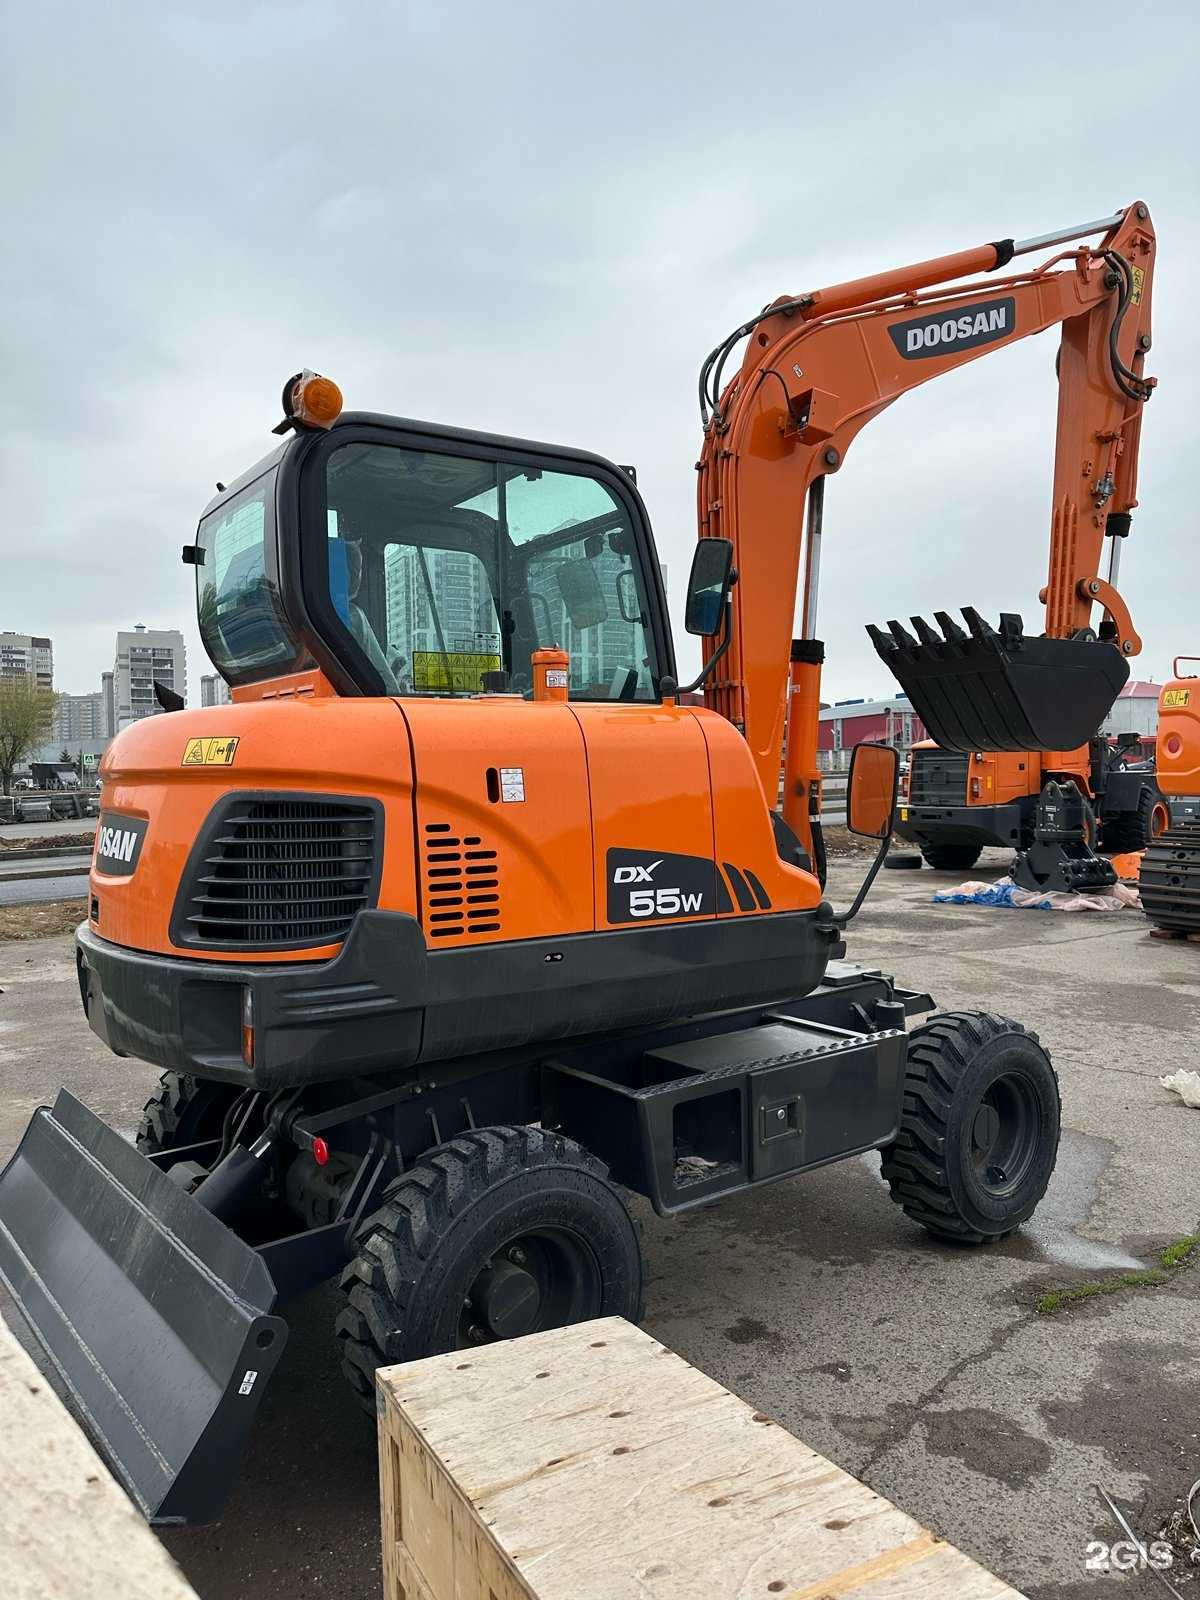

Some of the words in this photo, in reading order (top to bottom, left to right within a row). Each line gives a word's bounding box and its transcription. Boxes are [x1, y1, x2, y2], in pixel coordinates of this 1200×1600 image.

[906, 307, 1006, 352] DOOSAN
[98, 825, 138, 862] OSAN
[613, 859, 665, 884] DX
